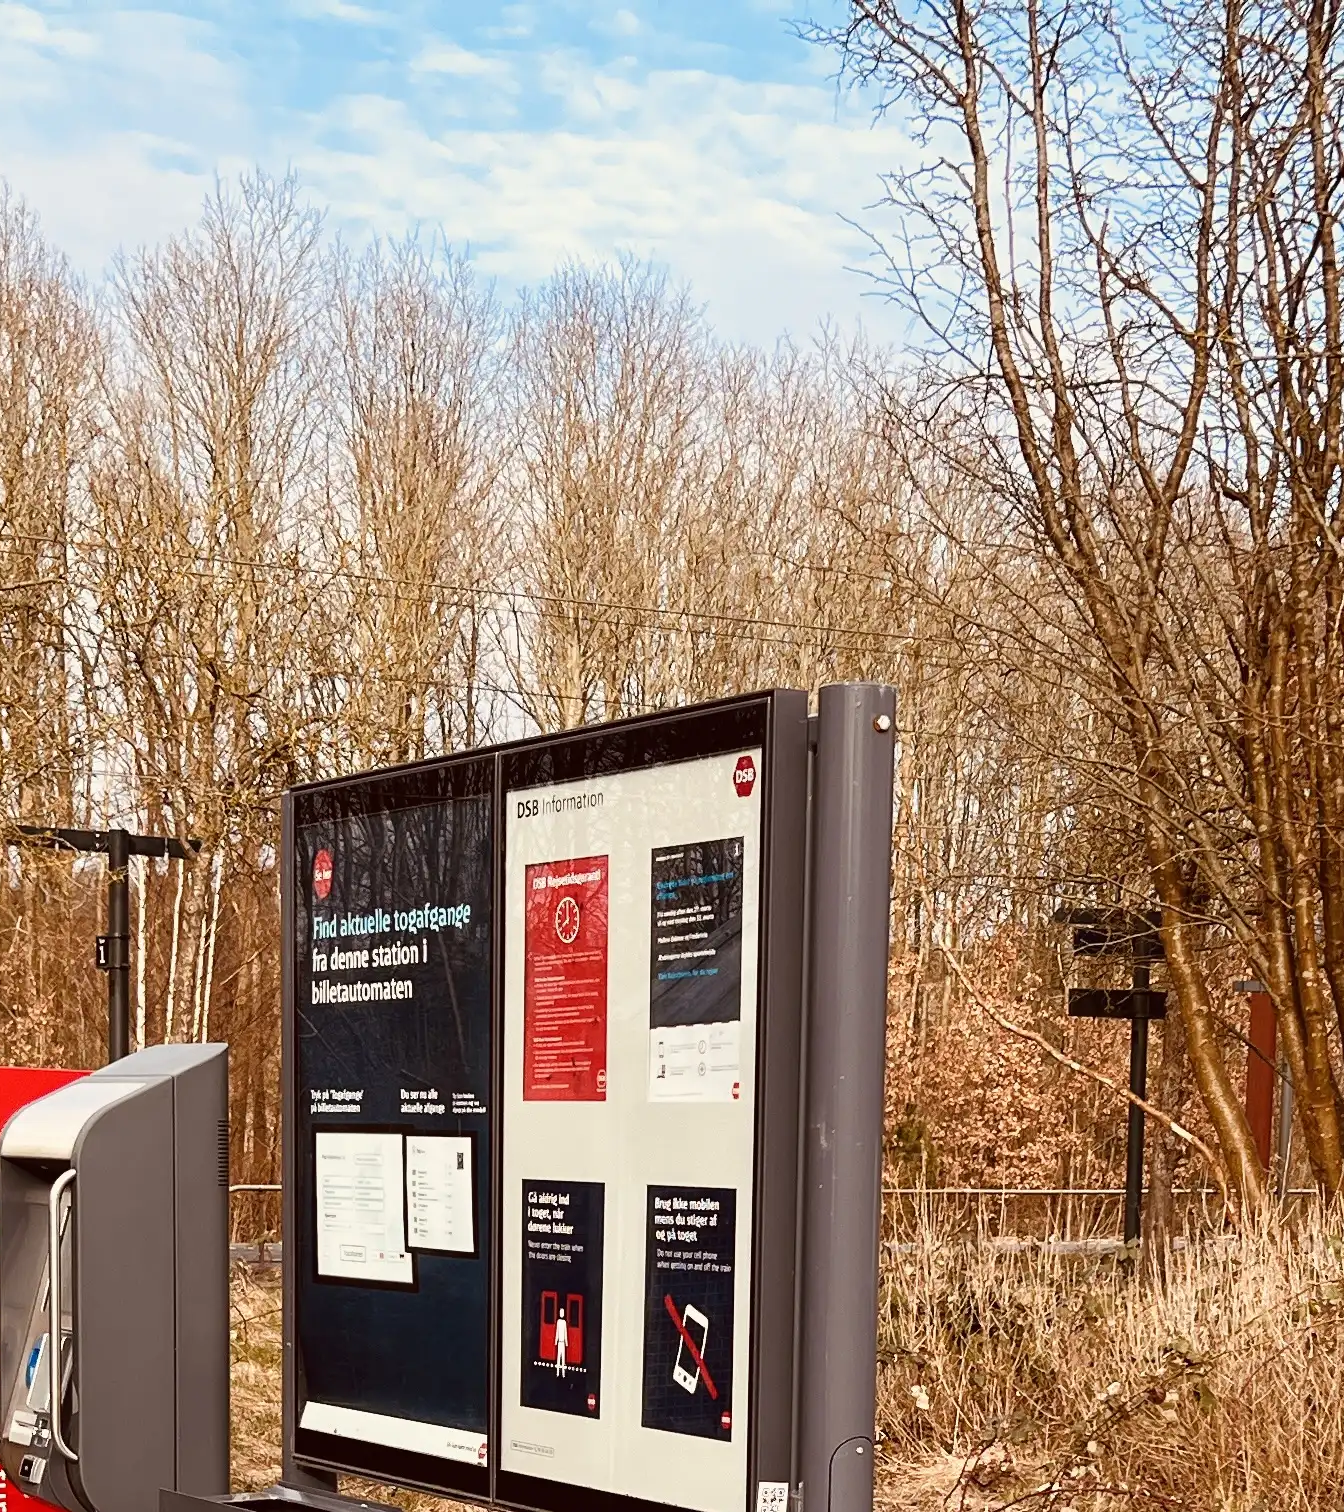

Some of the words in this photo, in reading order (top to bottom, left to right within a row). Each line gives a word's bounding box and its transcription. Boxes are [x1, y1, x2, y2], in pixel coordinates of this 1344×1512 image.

[735, 769, 754, 784] DSB
[517, 799, 539, 819] DSB
[542, 792, 604, 816] Information
[533, 876, 547, 890] DSB
[313, 914, 337, 940] Find
[340, 908, 391, 936] aktuelle
[394, 902, 471, 934] togafgange
[312, 948, 328, 973] fra
[330, 946, 369, 971] denne
[372, 941, 419, 967] station
[422, 938, 428, 963] i
[311, 978, 413, 1005] billetautomaten
[528, 1191, 537, 1203] Gå
[538, 1192, 558, 1207] aldrig
[558, 1193, 570, 1205] ind
[654, 1196, 672, 1211] Brug
[672, 1197, 688, 1210] ikke
[689, 1197, 720, 1211] mobilen
[654, 1215, 674, 1225] mens
[675, 1212, 686, 1226] du
[655, 1230, 666, 1242] og
[666, 1227, 677, 1242] på
[677, 1230, 698, 1243] toget
